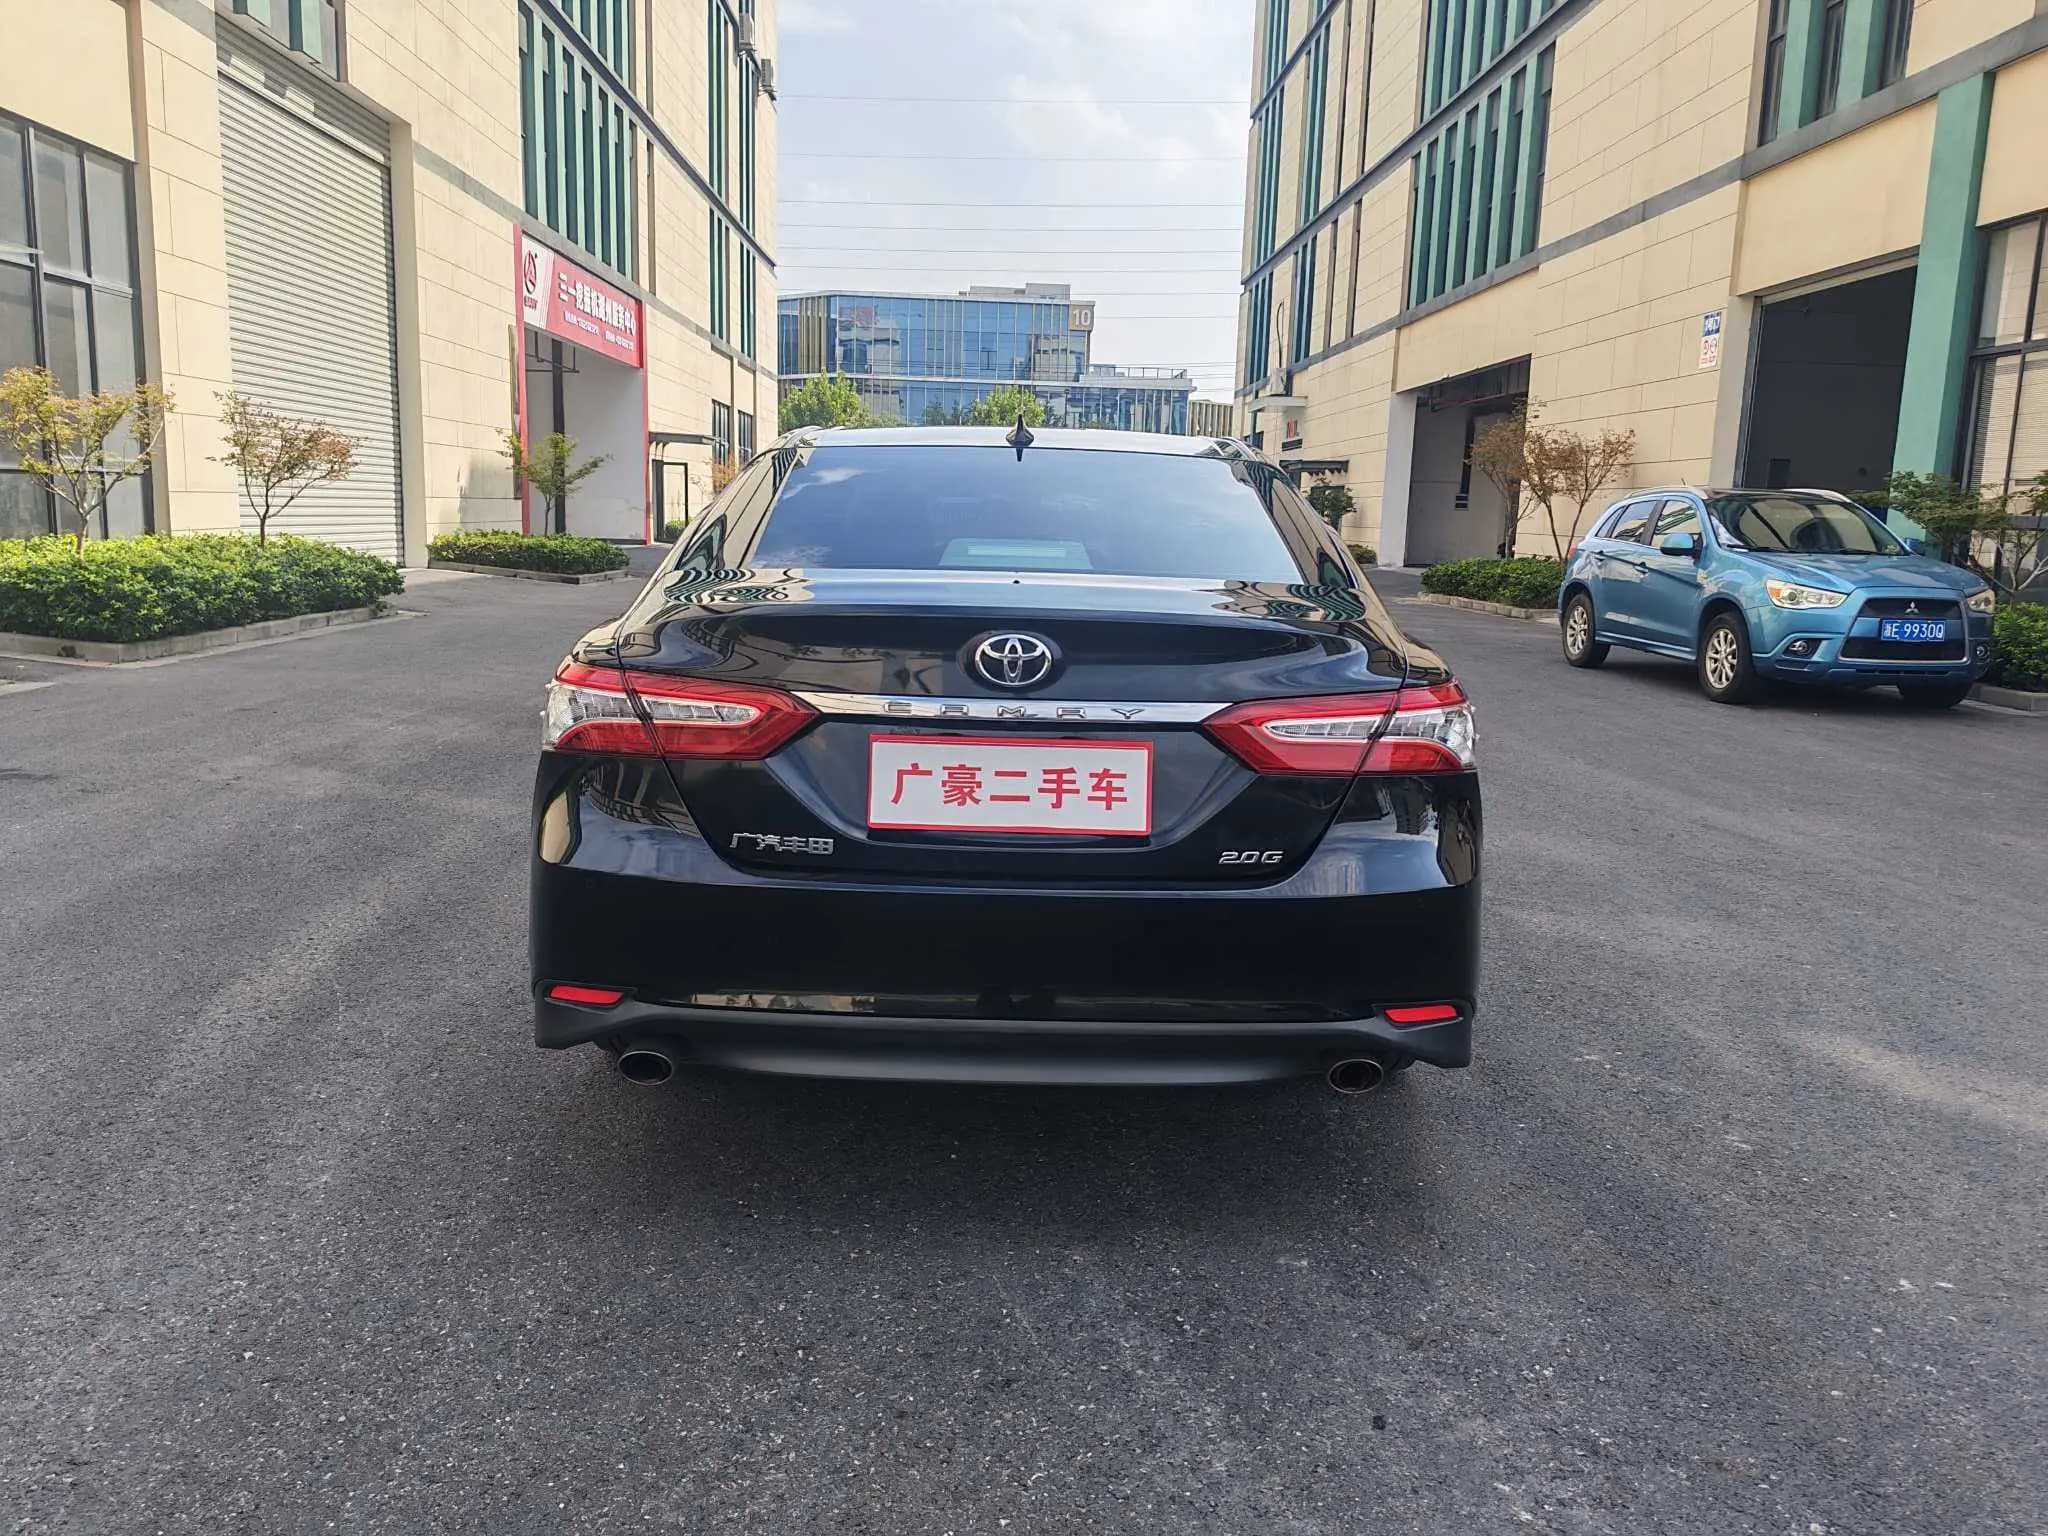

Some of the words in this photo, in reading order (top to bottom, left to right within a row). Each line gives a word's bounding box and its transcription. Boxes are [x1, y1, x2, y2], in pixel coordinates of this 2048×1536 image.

[1073, 309, 1091, 326] 10
[883, 701, 1144, 720] CAMRY
[891, 762, 1128, 811] 广豪二手车
[729, 832, 834, 855] 广汽丰田
